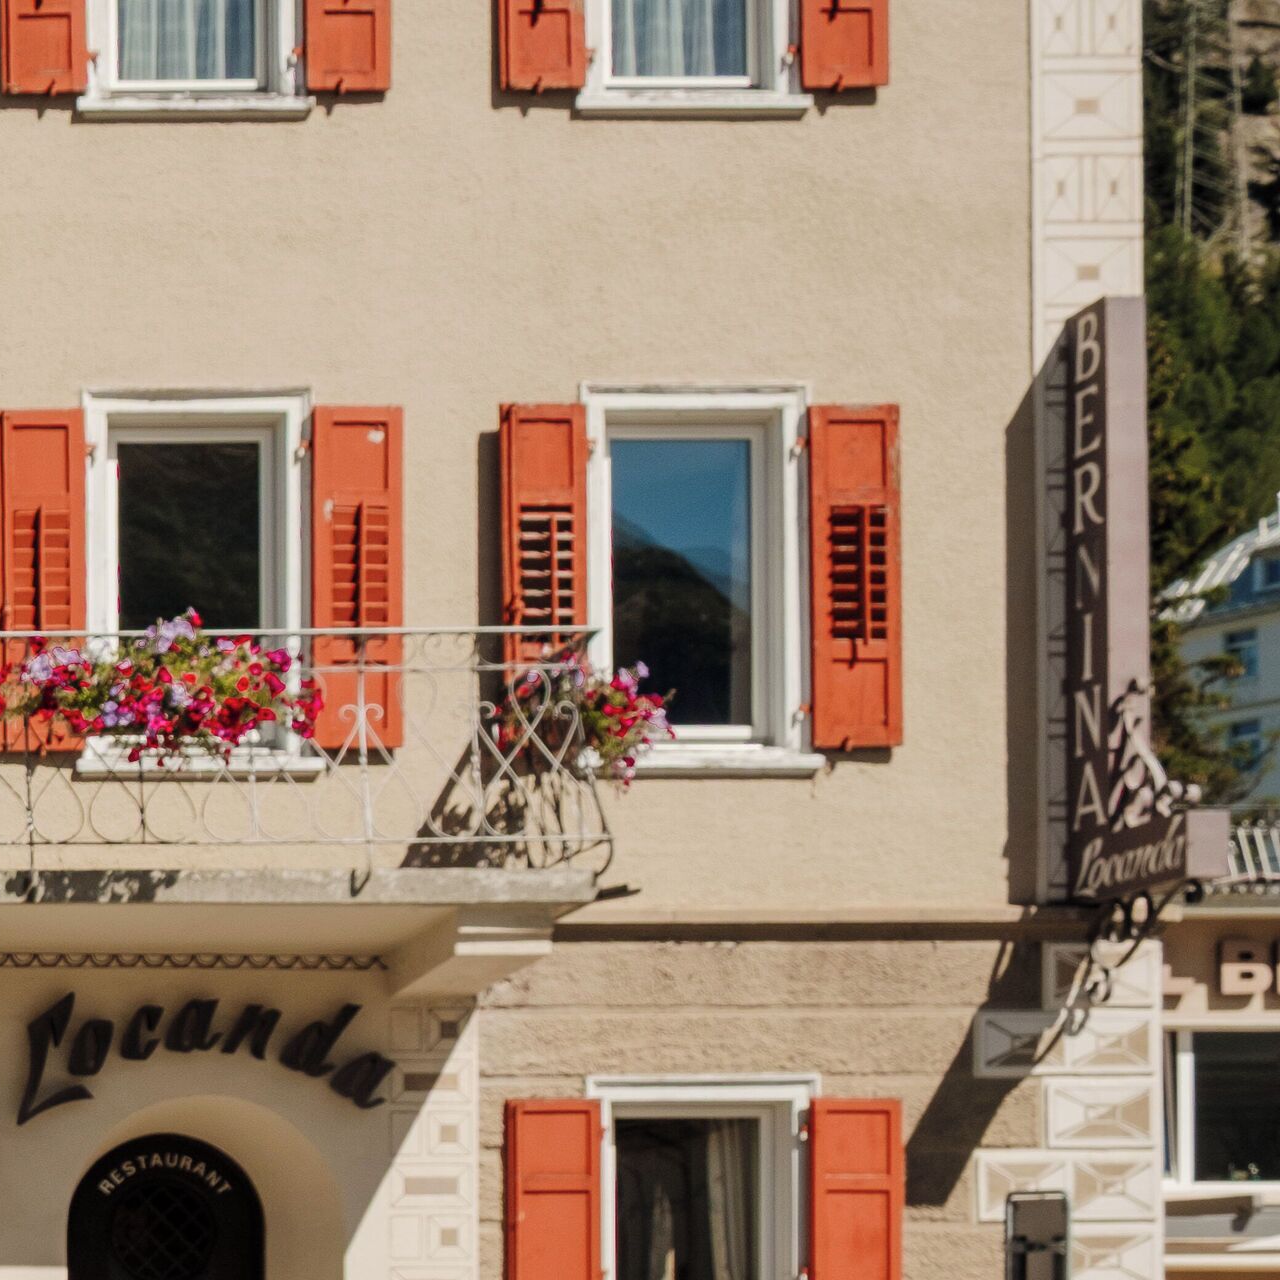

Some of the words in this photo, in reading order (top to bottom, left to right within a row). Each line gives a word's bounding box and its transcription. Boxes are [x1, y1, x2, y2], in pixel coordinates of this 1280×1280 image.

[1072, 311, 1107, 832] BERNINA
[1073, 812, 1185, 898] Locanda
[17, 991, 396, 1126] Locanda
[97, 1151, 232, 1196] RESTAURANT
